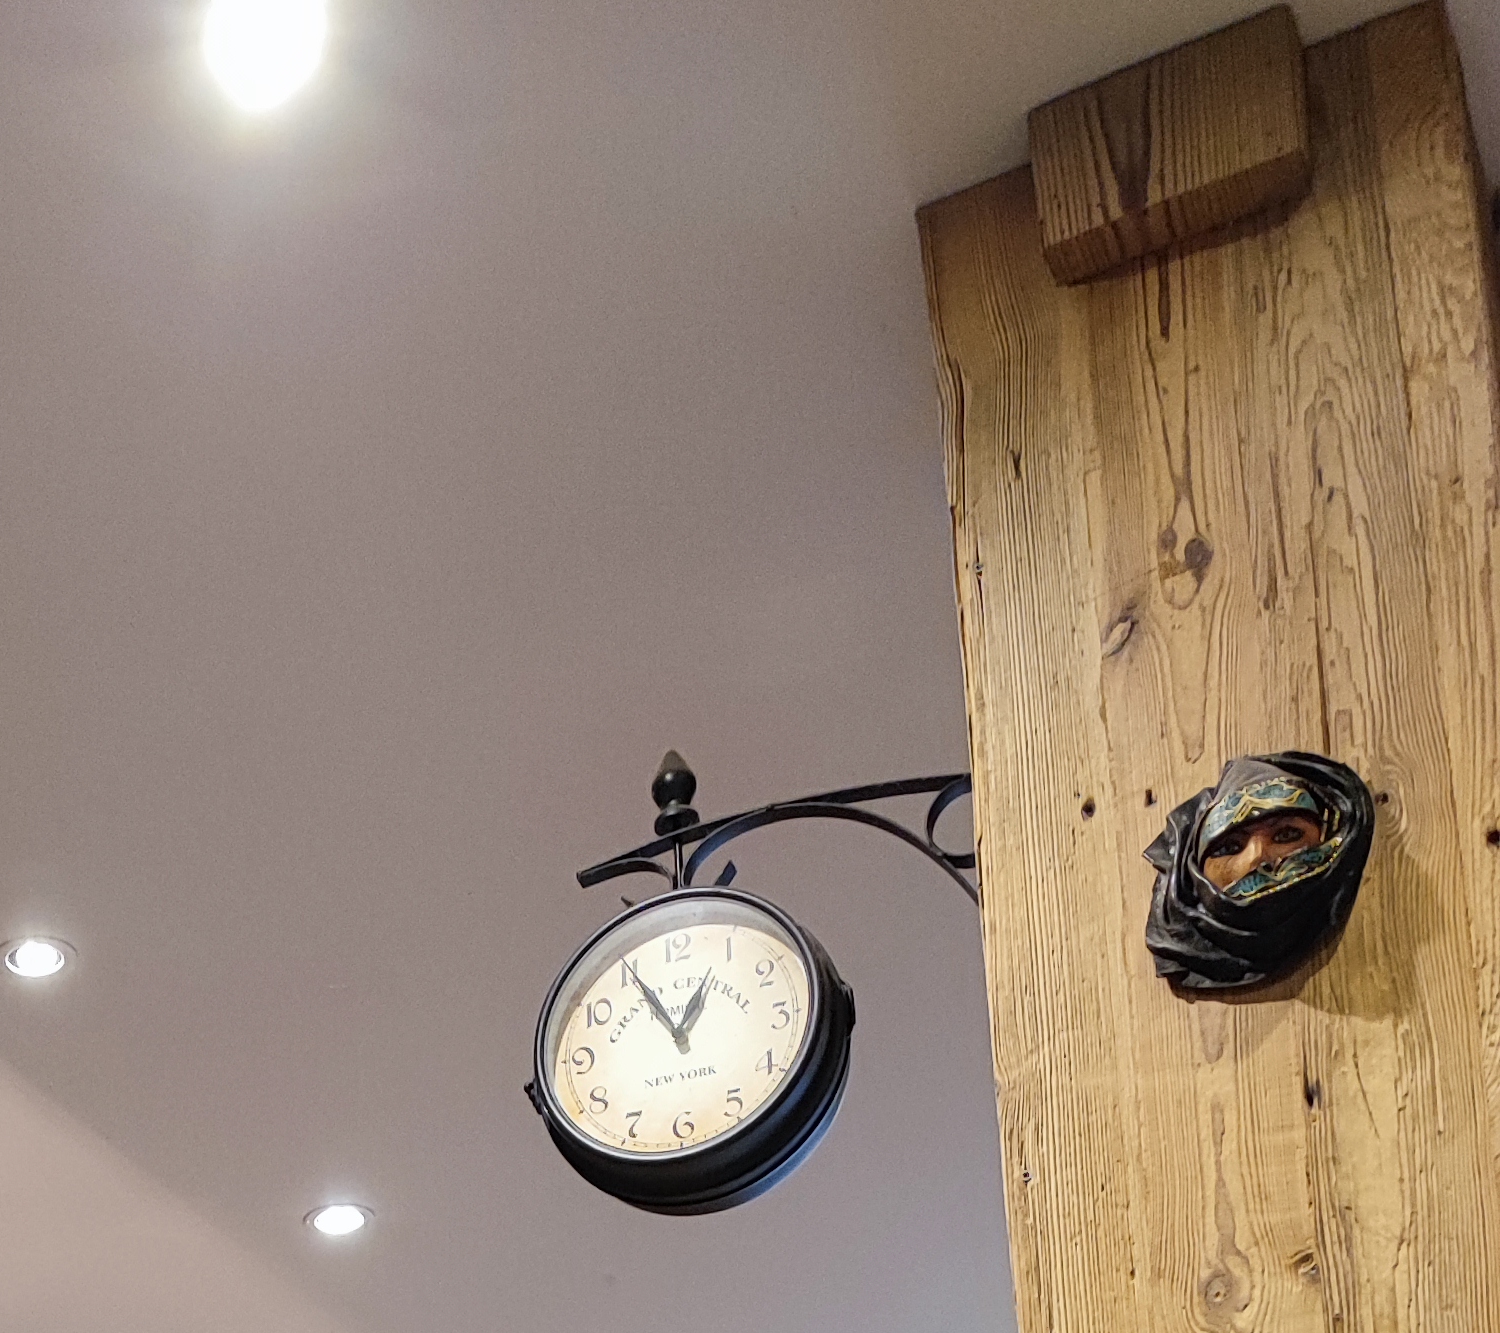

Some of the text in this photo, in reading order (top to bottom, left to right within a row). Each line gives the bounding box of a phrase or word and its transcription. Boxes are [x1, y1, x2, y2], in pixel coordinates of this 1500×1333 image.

[664, 933, 692, 963] 12
[724, 936, 733, 962] 1
[621, 957, 639, 988] 11
[755, 959, 775, 988] 2
[585, 997, 612, 1028] 10
[770, 1000, 791, 1031] 3
[571, 1046, 595, 1075] 9
[754, 1047, 779, 1076] 4
[644, 1065, 717, 1089] NEW YORK
[588, 1085, 609, 1114] 8
[723, 1087, 743, 1118] 5
[625, 1110, 643, 1139] 7
[672, 1111, 695, 1139] 6
